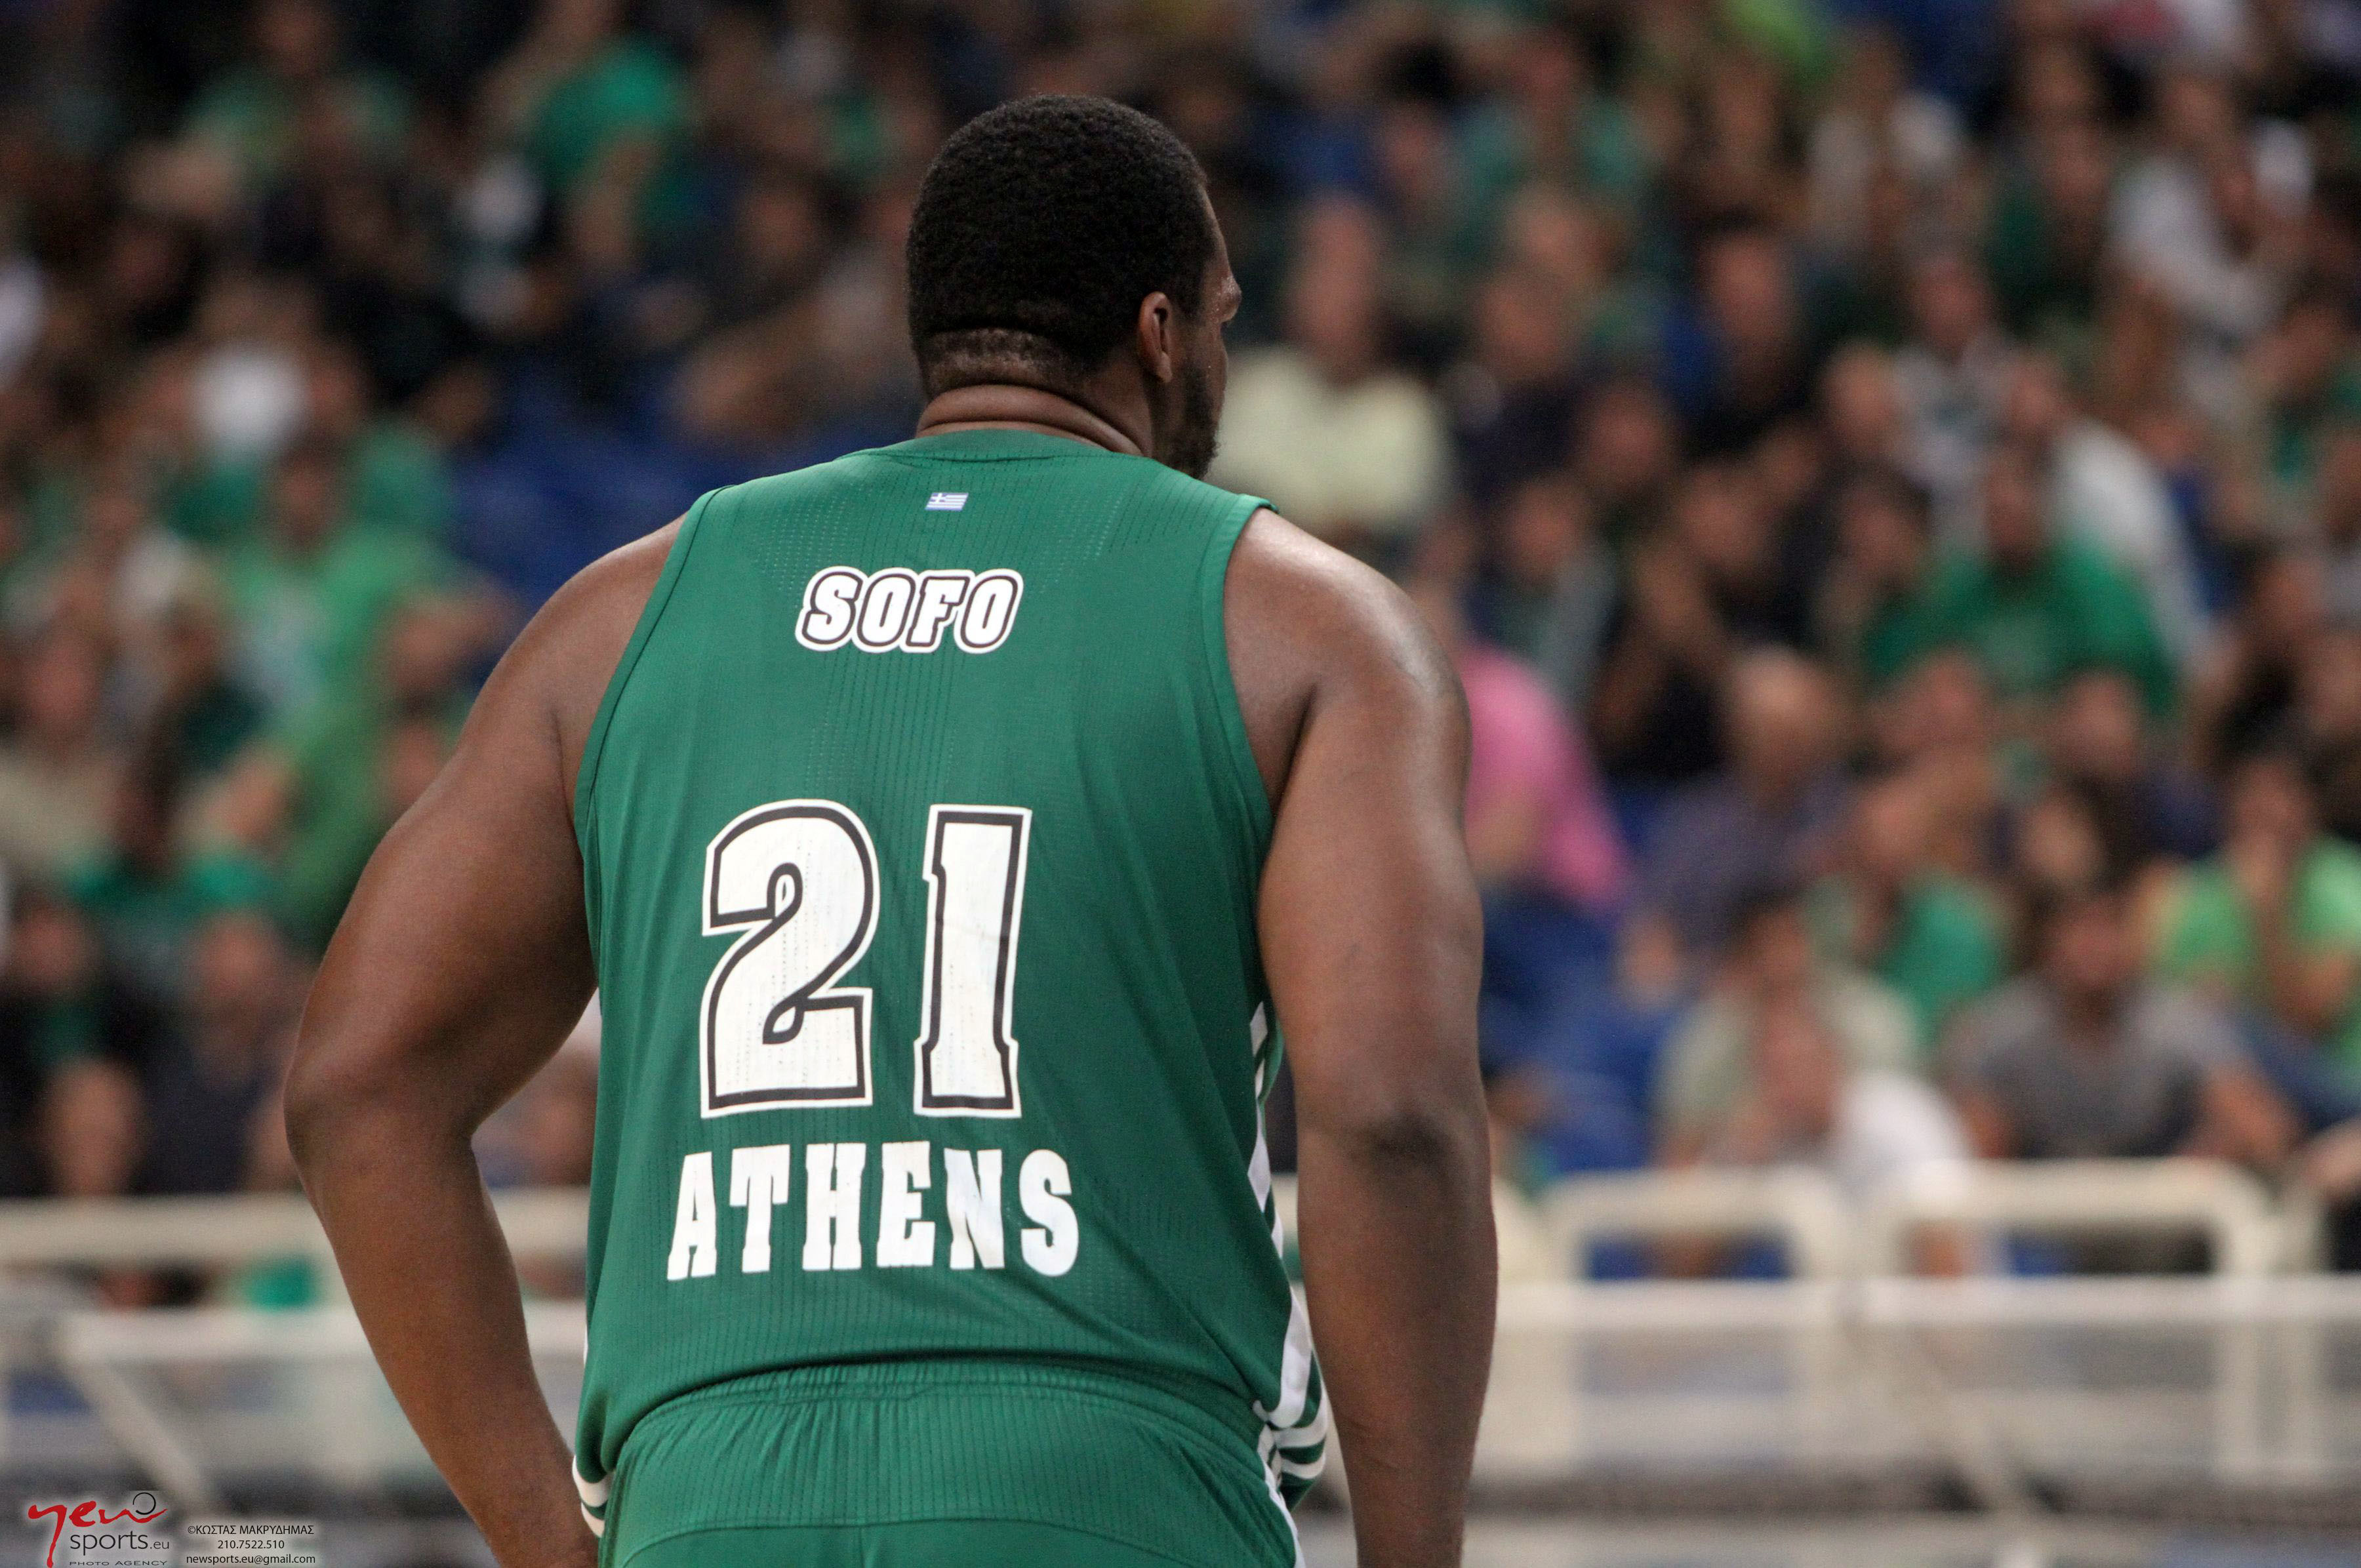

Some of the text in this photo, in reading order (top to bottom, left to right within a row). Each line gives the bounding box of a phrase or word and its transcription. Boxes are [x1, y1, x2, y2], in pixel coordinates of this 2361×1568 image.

[796, 565, 1024, 654] SOFO
[700, 799, 1032, 1119] 21
[667, 1141, 1079, 1280] ATHENS
